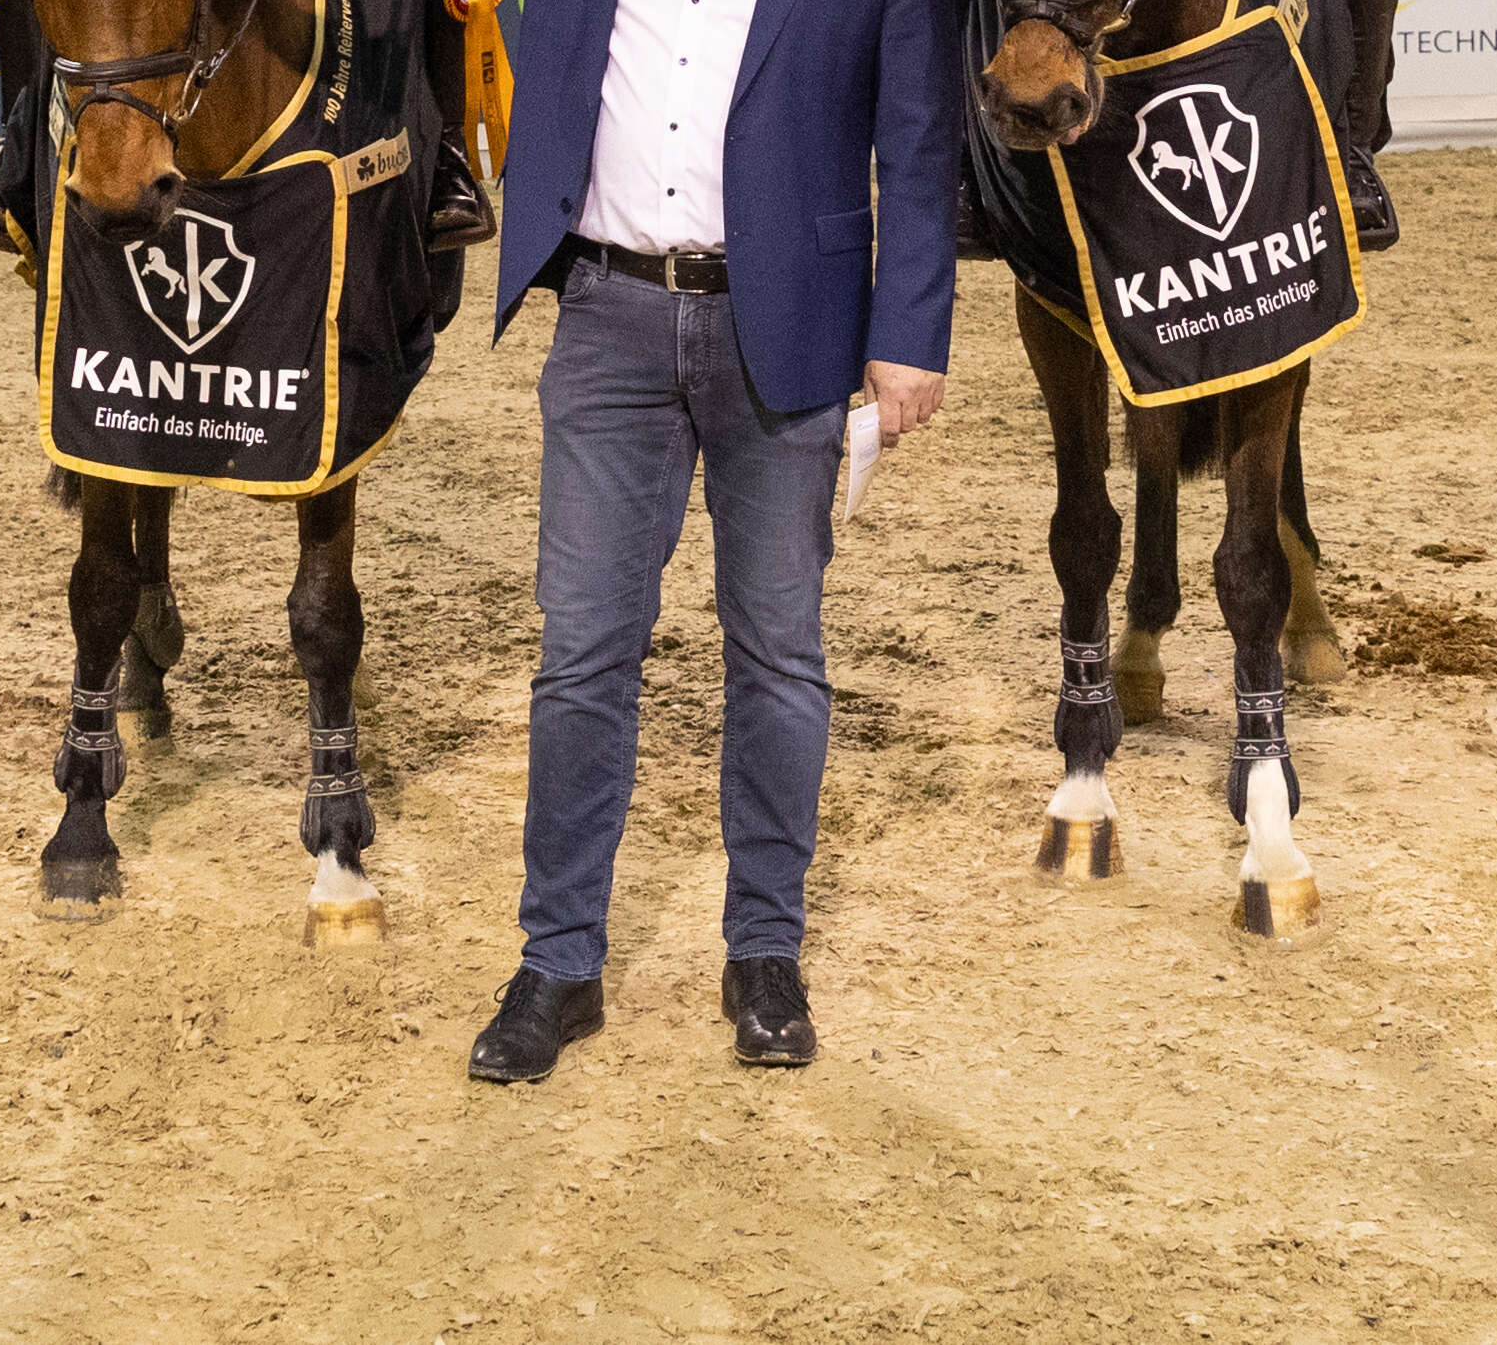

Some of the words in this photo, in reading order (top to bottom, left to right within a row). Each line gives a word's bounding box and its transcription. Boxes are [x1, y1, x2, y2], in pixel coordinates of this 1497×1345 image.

[329, 59, 352, 101] Jahre
[323, 97, 342, 125] 100
[1155, 312, 1221, 345] Einfach
[1223, 304, 1254, 327] das
[1256, 279, 1319, 317] Richtige.
[94, 406, 159, 433] Einfach
[164, 414, 194, 438] das
[198, 418, 268, 448] Richtige.
